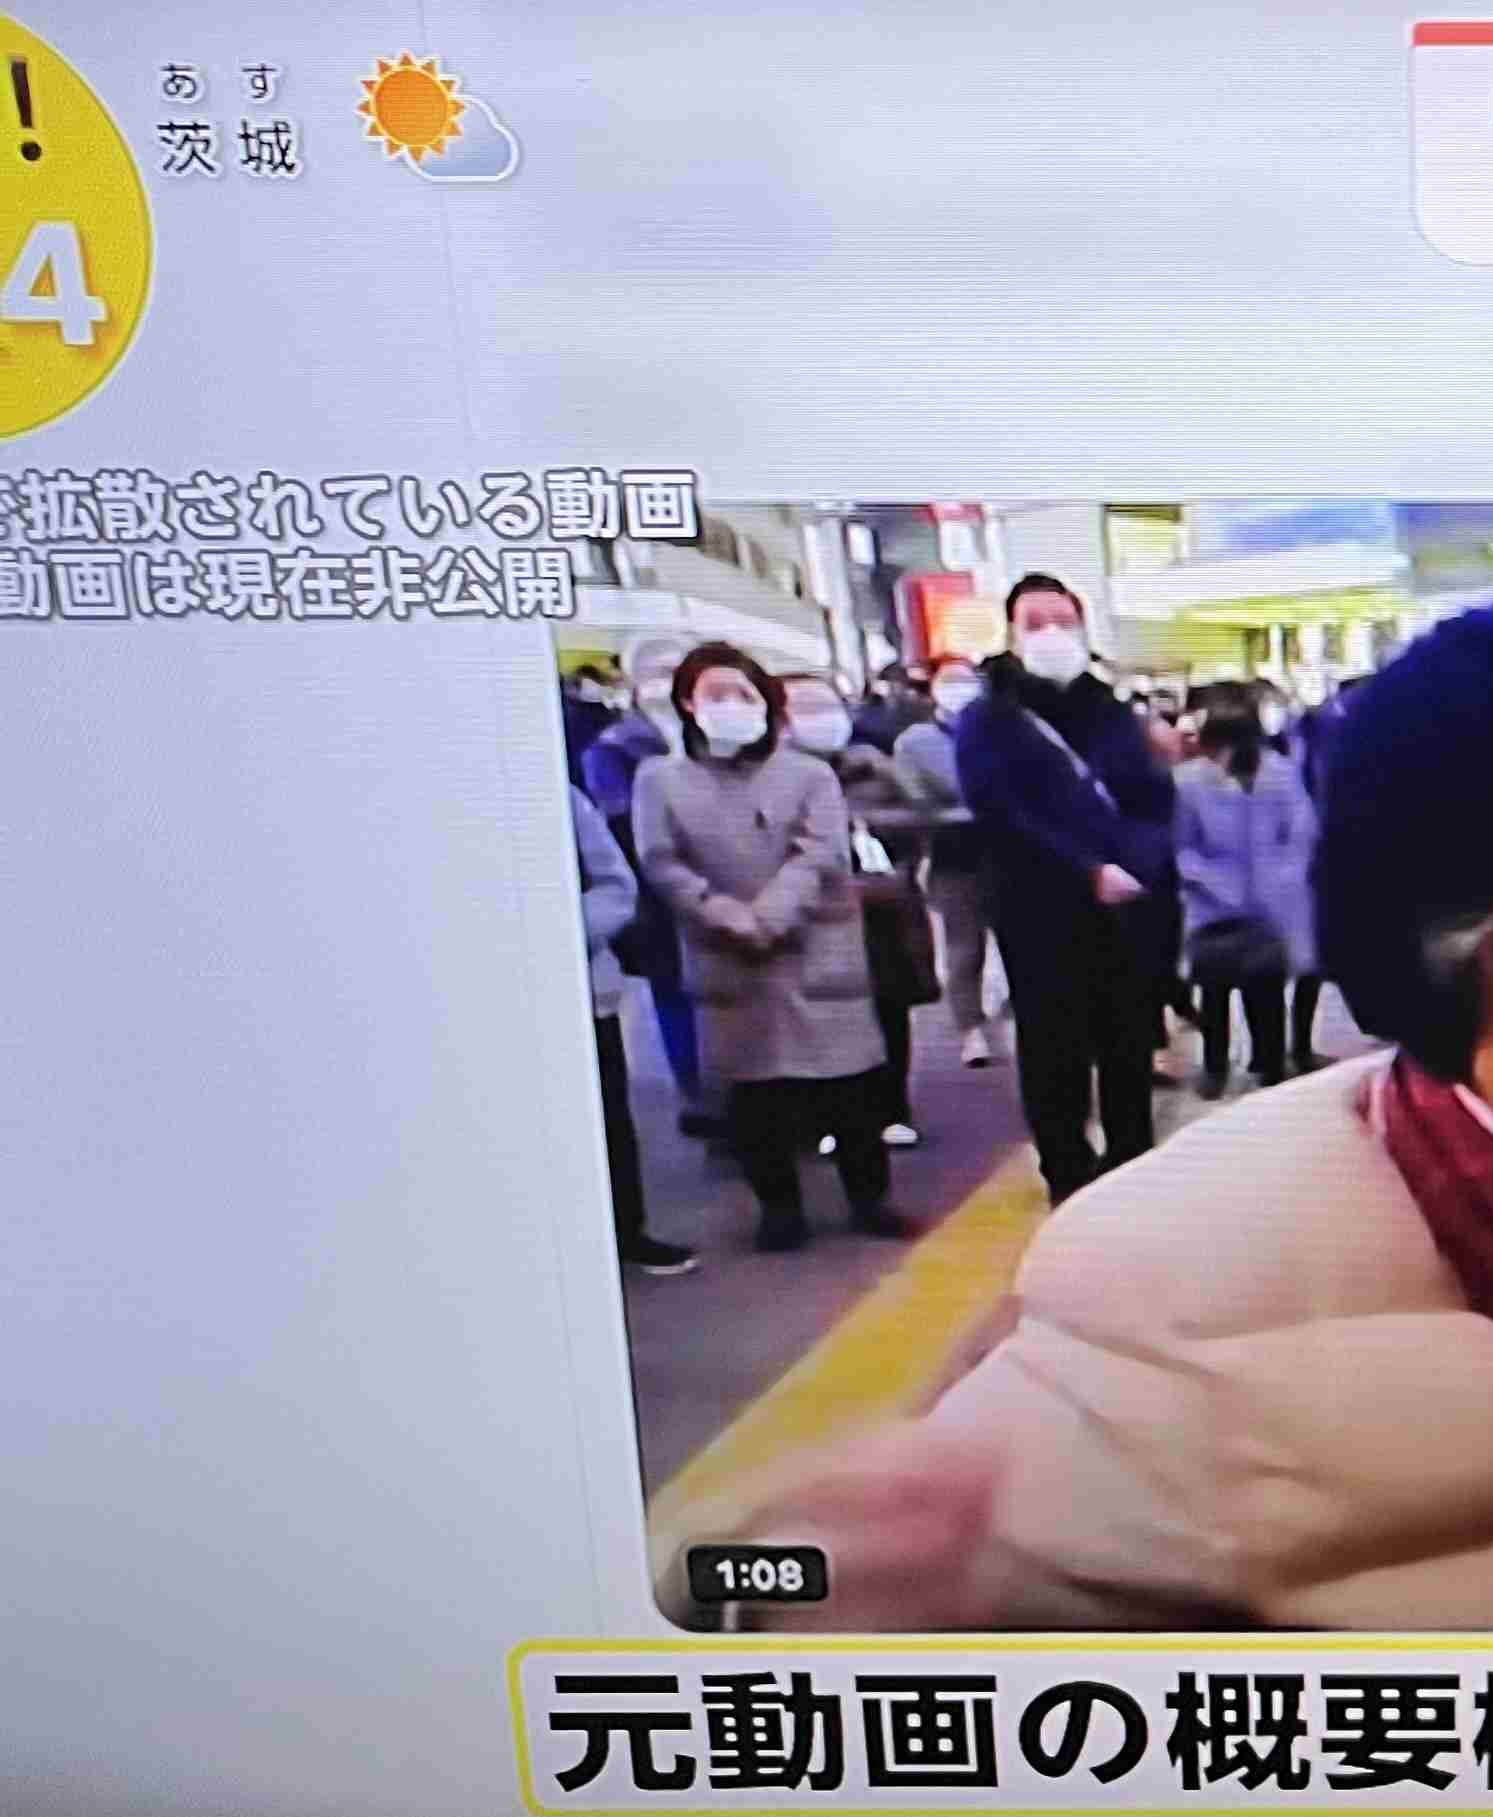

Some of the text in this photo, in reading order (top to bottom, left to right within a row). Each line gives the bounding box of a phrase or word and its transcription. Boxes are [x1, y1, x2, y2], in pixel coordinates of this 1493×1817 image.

[156, 120, 297, 174] 茨城
[0, 468, 700, 543] 拡散されている動画
[716, 1558, 804, 1591] 1:08
